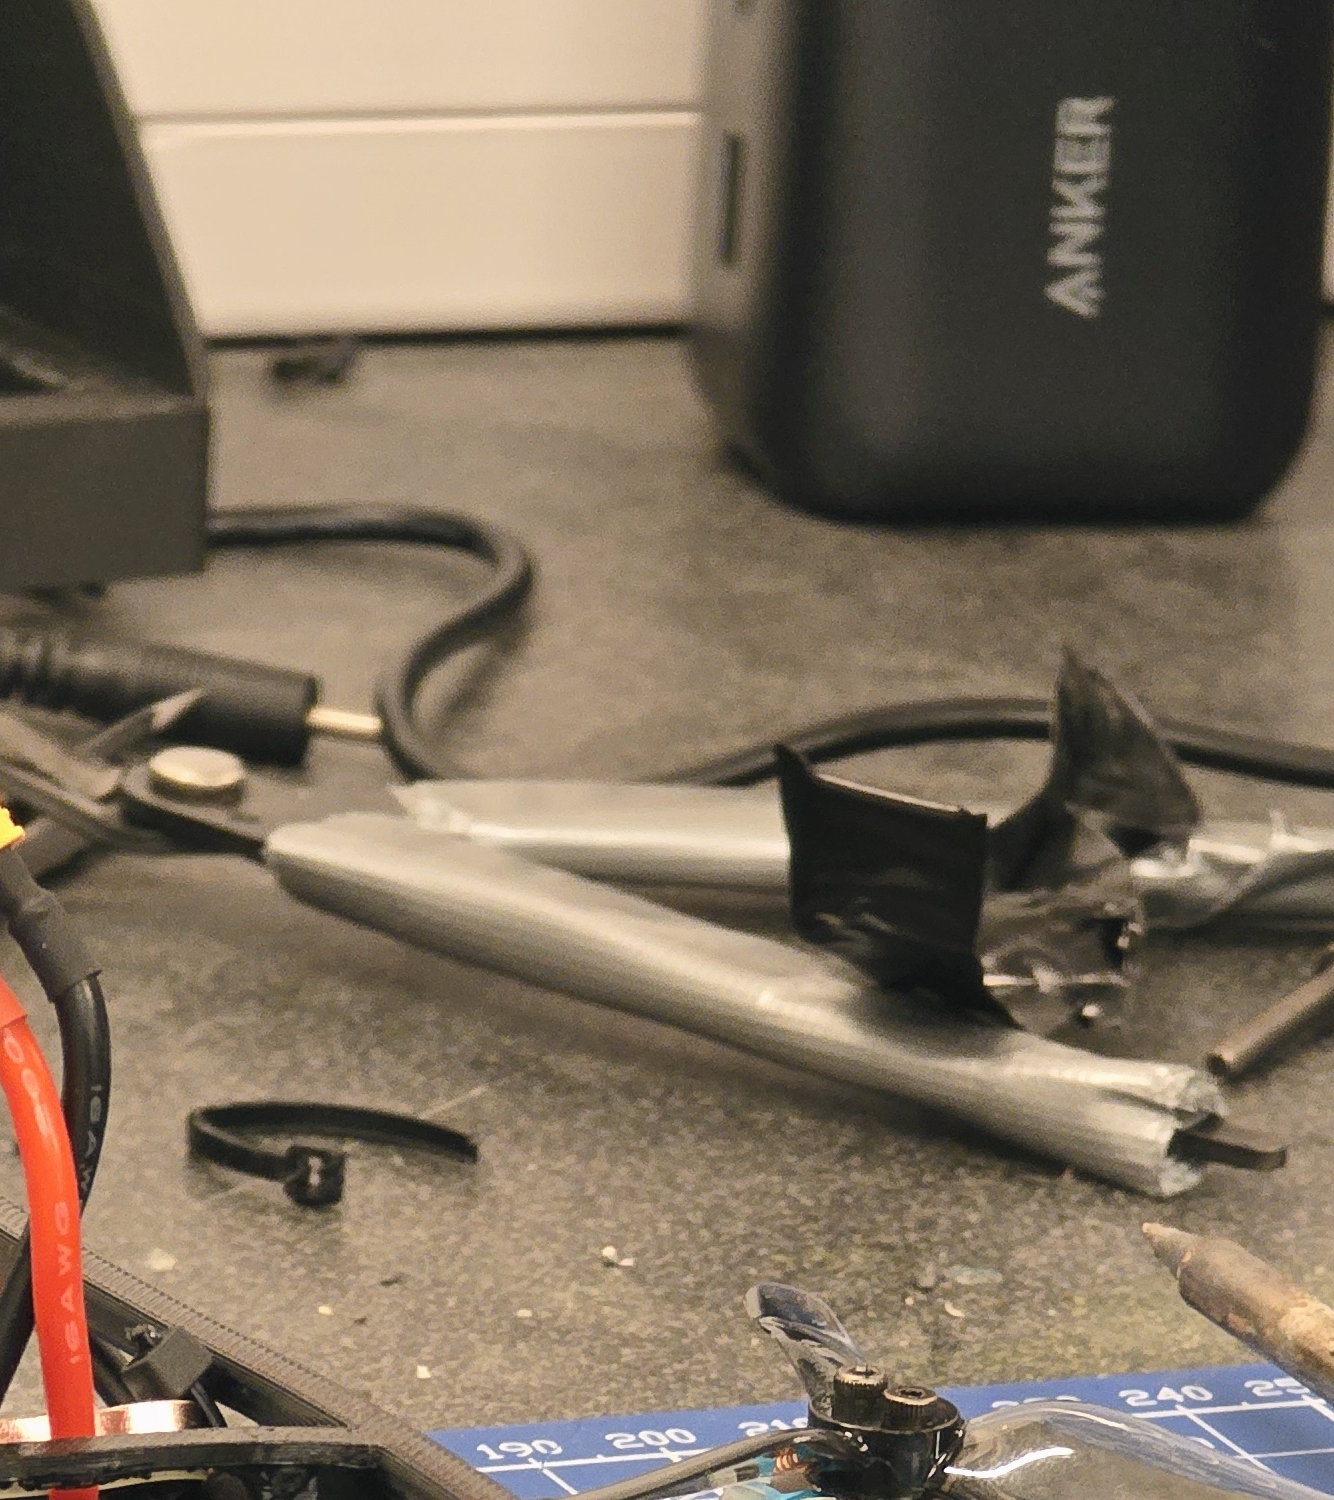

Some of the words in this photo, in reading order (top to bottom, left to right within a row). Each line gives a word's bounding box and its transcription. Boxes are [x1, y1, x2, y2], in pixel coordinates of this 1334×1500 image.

[1044, 96, 1116, 319] ANKER
[476, 1438, 564, 1461] 190
[604, 1427, 697, 1450] 200
[1117, 1383, 1214, 1407] 240
